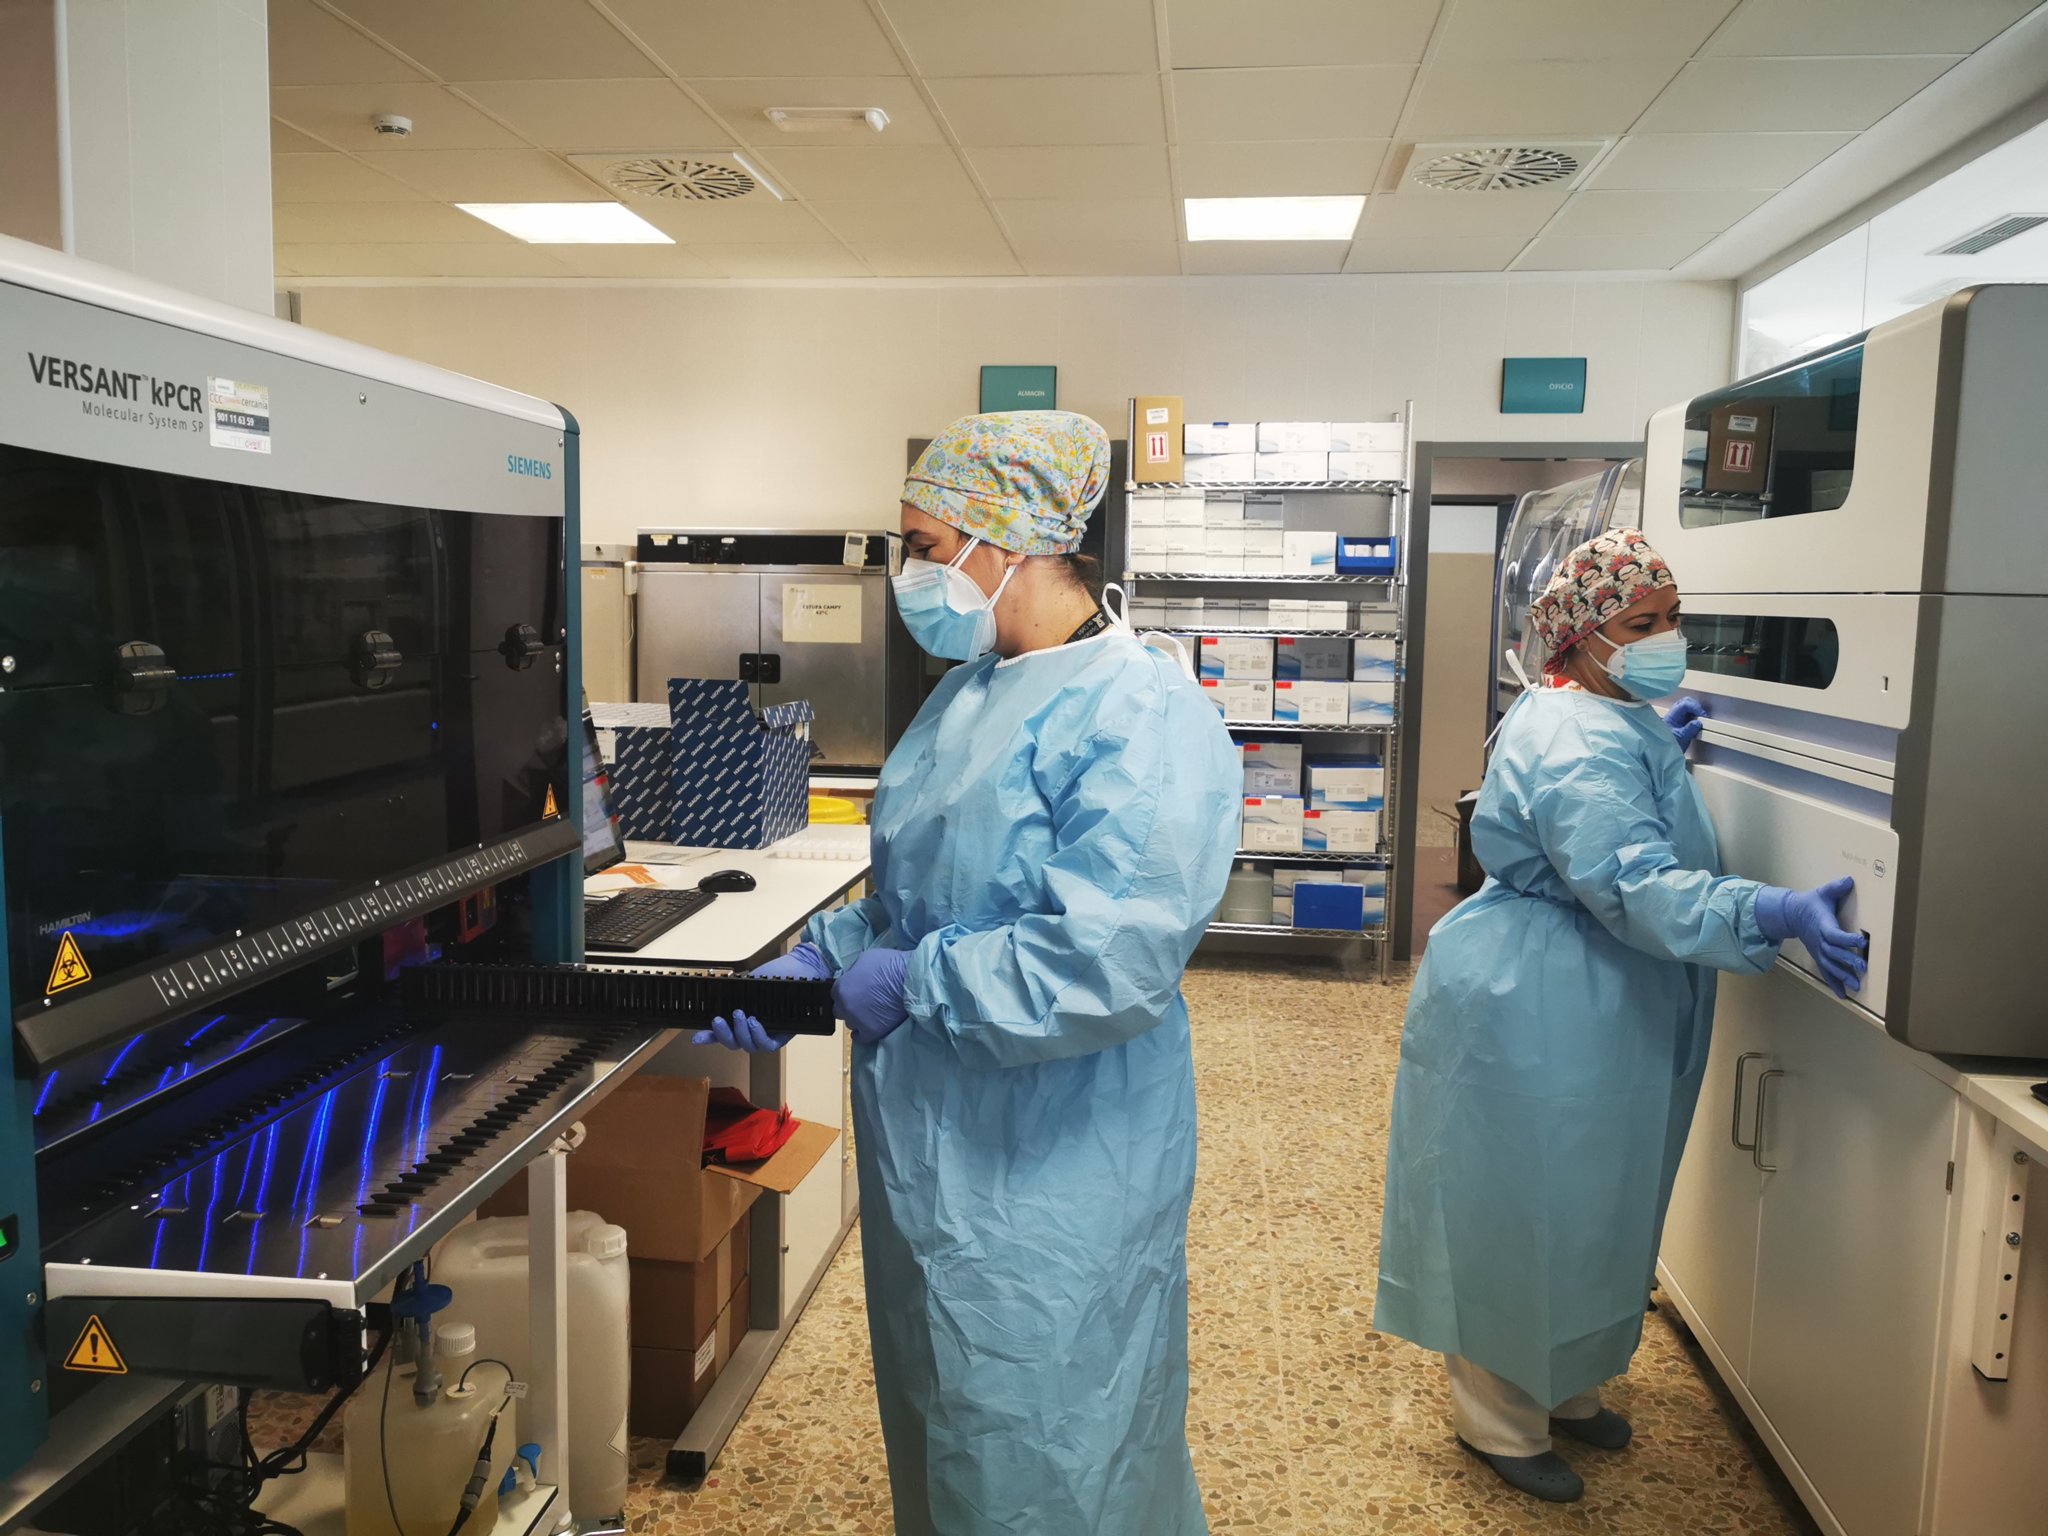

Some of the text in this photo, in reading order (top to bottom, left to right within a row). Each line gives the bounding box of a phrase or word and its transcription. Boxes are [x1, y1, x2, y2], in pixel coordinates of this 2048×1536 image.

[151, 376, 202, 414] kPCR
[82, 400, 203, 432] Molecular System SP
[217, 412, 228, 422] 901
[230, 415, 236, 423] 11
[508, 454, 551, 480] SIEMENS
[679, 680, 692, 694] QIAGEN
[710, 685, 724, 699] QIAGEN
[673, 698, 686, 712] QIAGEN
[692, 692, 705, 706] QIAGEN
[723, 698, 736, 712] QIAGEN
[686, 710, 699, 725] QIAGEN
[705, 704, 718, 718] QIAGEN
[736, 710, 750, 724] QIAGEN
[698, 723, 712, 737] QIAGEN
[717, 717, 731, 730] QIAGEN
[680, 729, 694, 744] QIAGEN
[710, 735, 724, 749] QIAGEN
[729, 729, 744, 743] QIAGEN
[672, 748, 686, 763] QIAGEN
[691, 742, 705, 756] QIAGEN
[722, 748, 736, 762] QIAGEN
[741, 741, 756, 756] QIAGEN
[702, 754, 717, 769] QIAGEN
[734, 761, 748, 775] QIAGEN
[683, 762, 698, 776] QIAGEN
[714, 768, 729, 782] QIAGEN
[695, 774, 709, 788] QIAGEN
[726, 780, 740, 794] QIAGEN
[745, 773, 759, 788] QIAGEN
[676, 781, 690, 795] QIAGEN
[706, 786, 721, 801] QIAGEN
[688, 793, 702, 808] QIAGEN
[718, 799, 732, 813] QIAGEN
[738, 792, 752, 807] QIAGEN
[680, 812, 694, 827] QIAGEN
[699, 806, 714, 820] QIAGEN
[730, 812, 744, 826] QIAGEN
[692, 825, 706, 839] QIAGEN
[711, 819, 725, 833] QIAGEN
[742, 824, 756, 839] QIAGEN
[673, 832, 687, 846] QIAGEN
[723, 831, 737, 845] QIAGEN
[162, 976, 170, 986] 1
[230, 950, 237, 959] 5
[302, 921, 312, 931] 10
[366, 897, 376, 907] 15
[421, 877, 430, 886] 20
